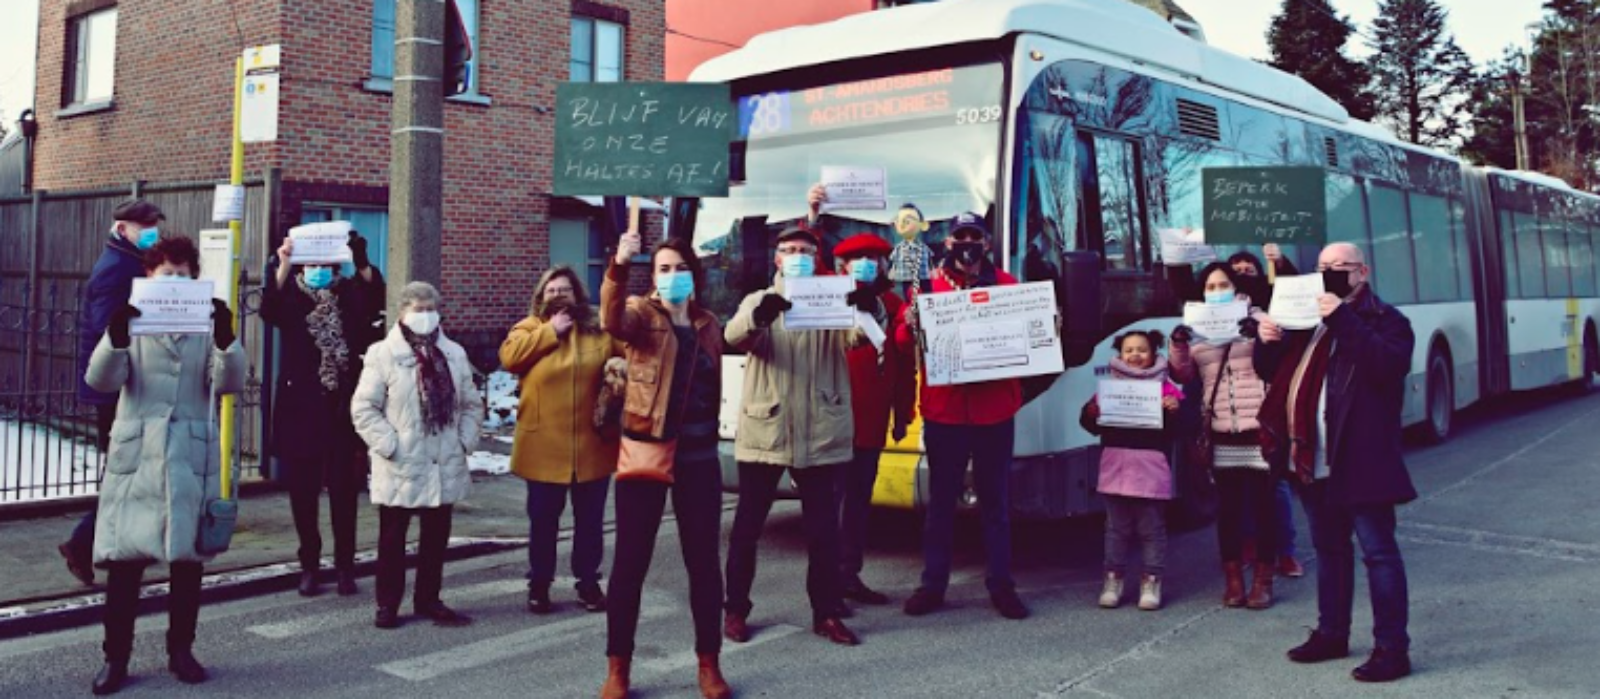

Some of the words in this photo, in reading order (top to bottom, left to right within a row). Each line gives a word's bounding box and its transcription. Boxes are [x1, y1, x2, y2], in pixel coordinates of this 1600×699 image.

[569, 96, 660, 128] BLIJF
[747, 92, 781, 134] 38
[810, 90, 949, 126] ACHTENDRIES
[956, 104, 1001, 125] 5039
[583, 134, 669, 154] ONZE
[564, 159, 653, 181] HALTES
[1213, 177, 1288, 200] BEPERK
